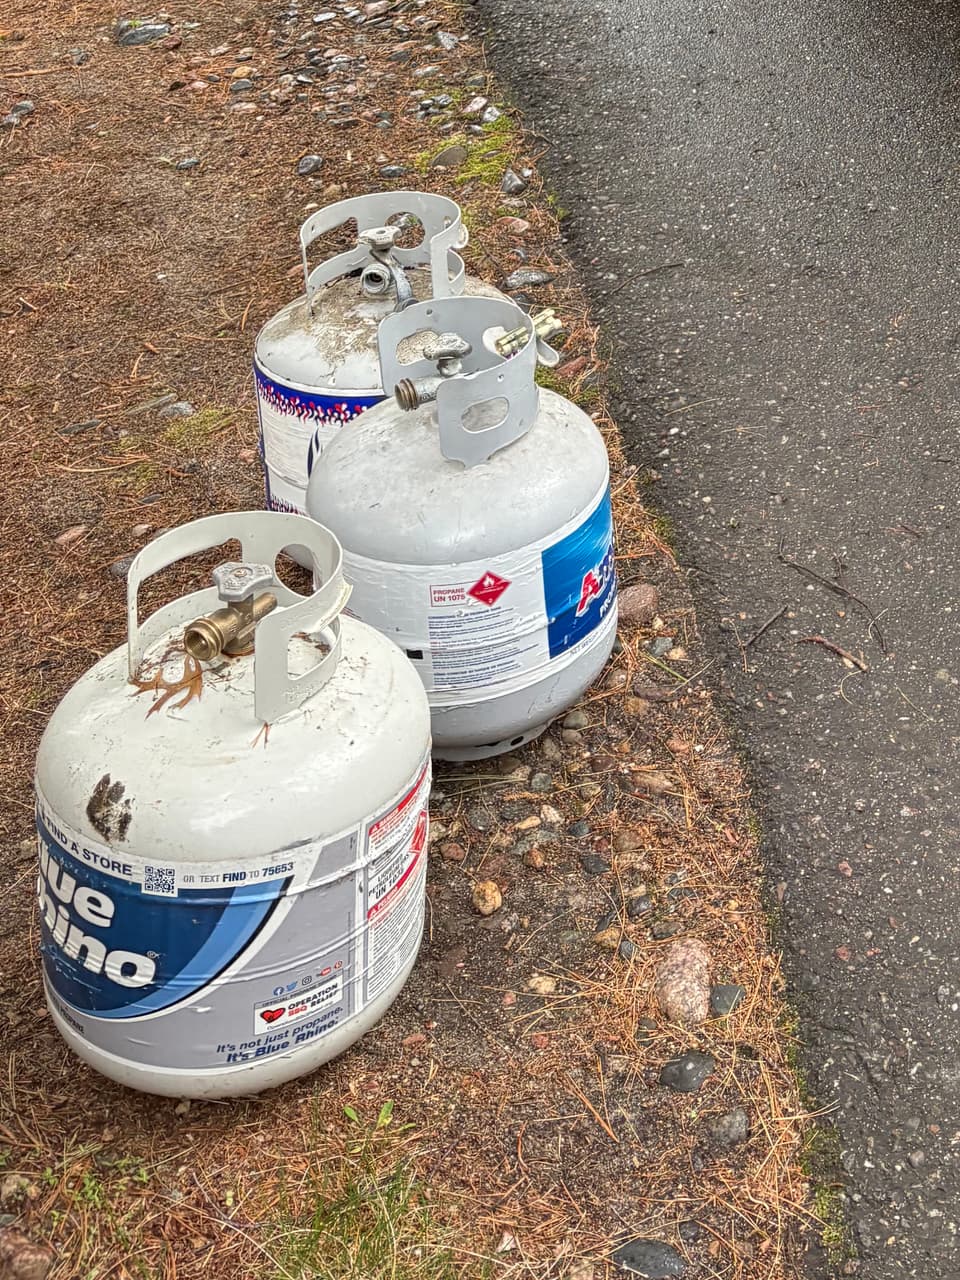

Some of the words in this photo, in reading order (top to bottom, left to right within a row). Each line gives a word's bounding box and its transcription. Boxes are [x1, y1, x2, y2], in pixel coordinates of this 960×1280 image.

[71, 841, 80, 855] A
[83, 847, 133, 876] STORE
[200, 874, 220, 883] TEXT
[222, 871, 247, 883] FIND
[249, 869, 260, 879] TO
[262, 861, 295, 877] 75653
[288, 982, 339, 1010] OPERATION
[310, 989, 340, 1008] RELIEF
[216, 1043, 236, 1053] It's
[239, 1038, 262, 1050] not
[263, 1030, 289, 1046] just
[292, 1006, 344, 1037] propane.
[226, 1052, 249, 1063] It's
[254, 1041, 290, 1058] Blue
